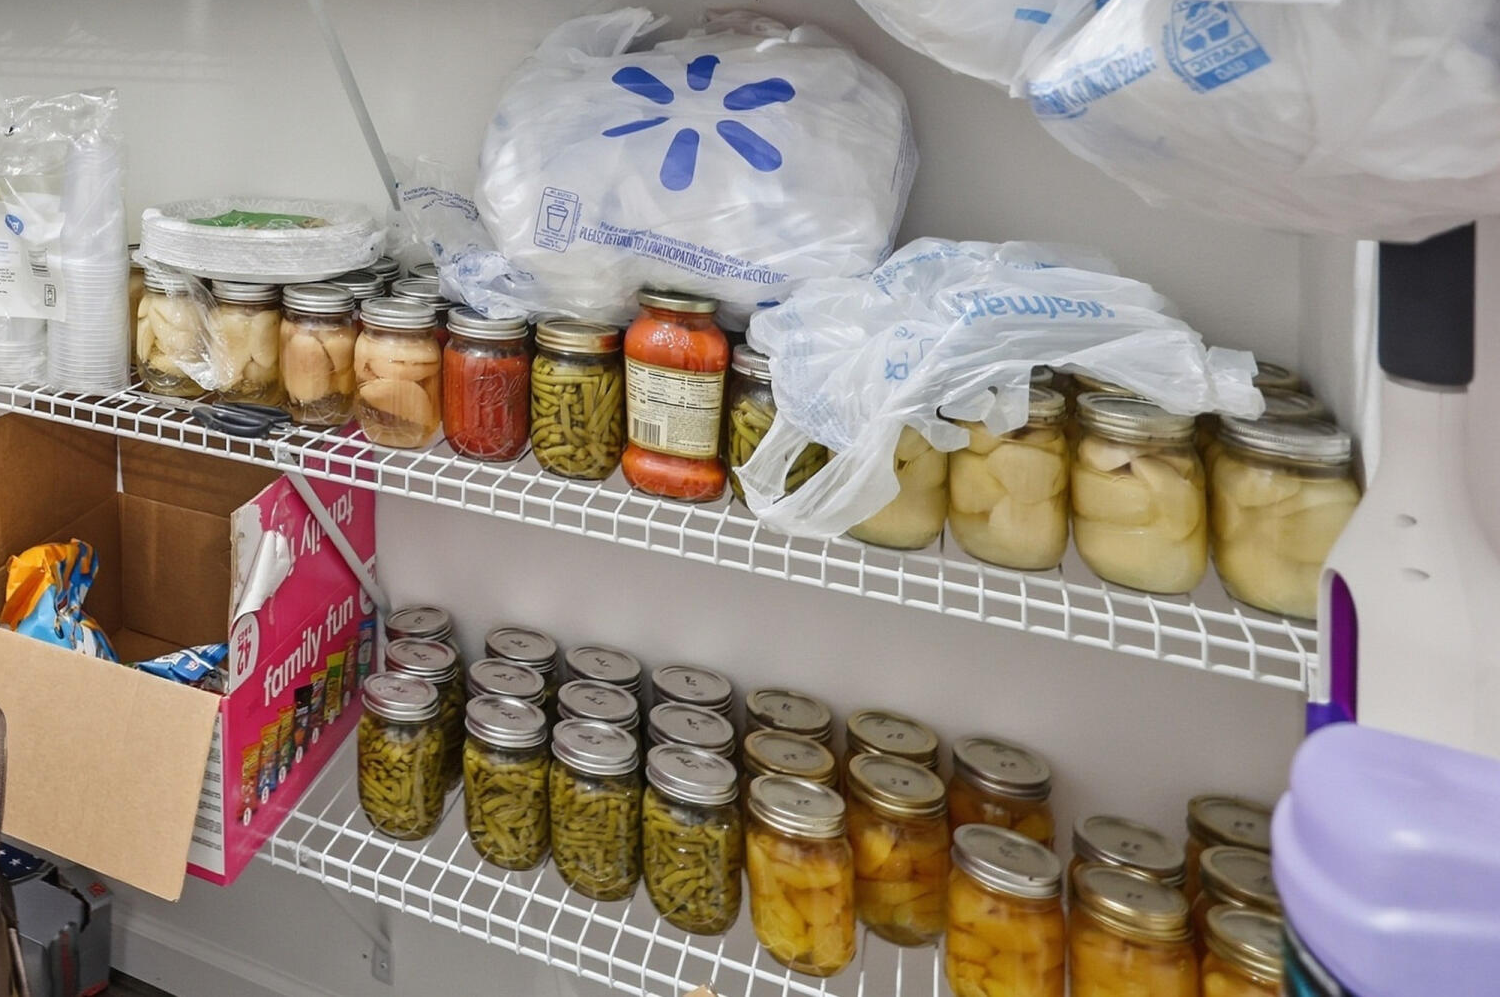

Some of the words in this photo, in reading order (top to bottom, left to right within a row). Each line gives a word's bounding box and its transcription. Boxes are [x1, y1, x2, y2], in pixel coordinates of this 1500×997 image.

[579, 226, 603, 245] PLEASE
[603, 233, 633, 250] RETURN
[633, 236, 643, 250] TO
[647, 240, 702, 269] PARTICIPATING
[701, 257, 727, 277] STORE
[727, 263, 742, 279] FOR
[742, 264, 788, 285] RECYCLING
[263, 624, 324, 707] family
[325, 594, 354, 642] fun
